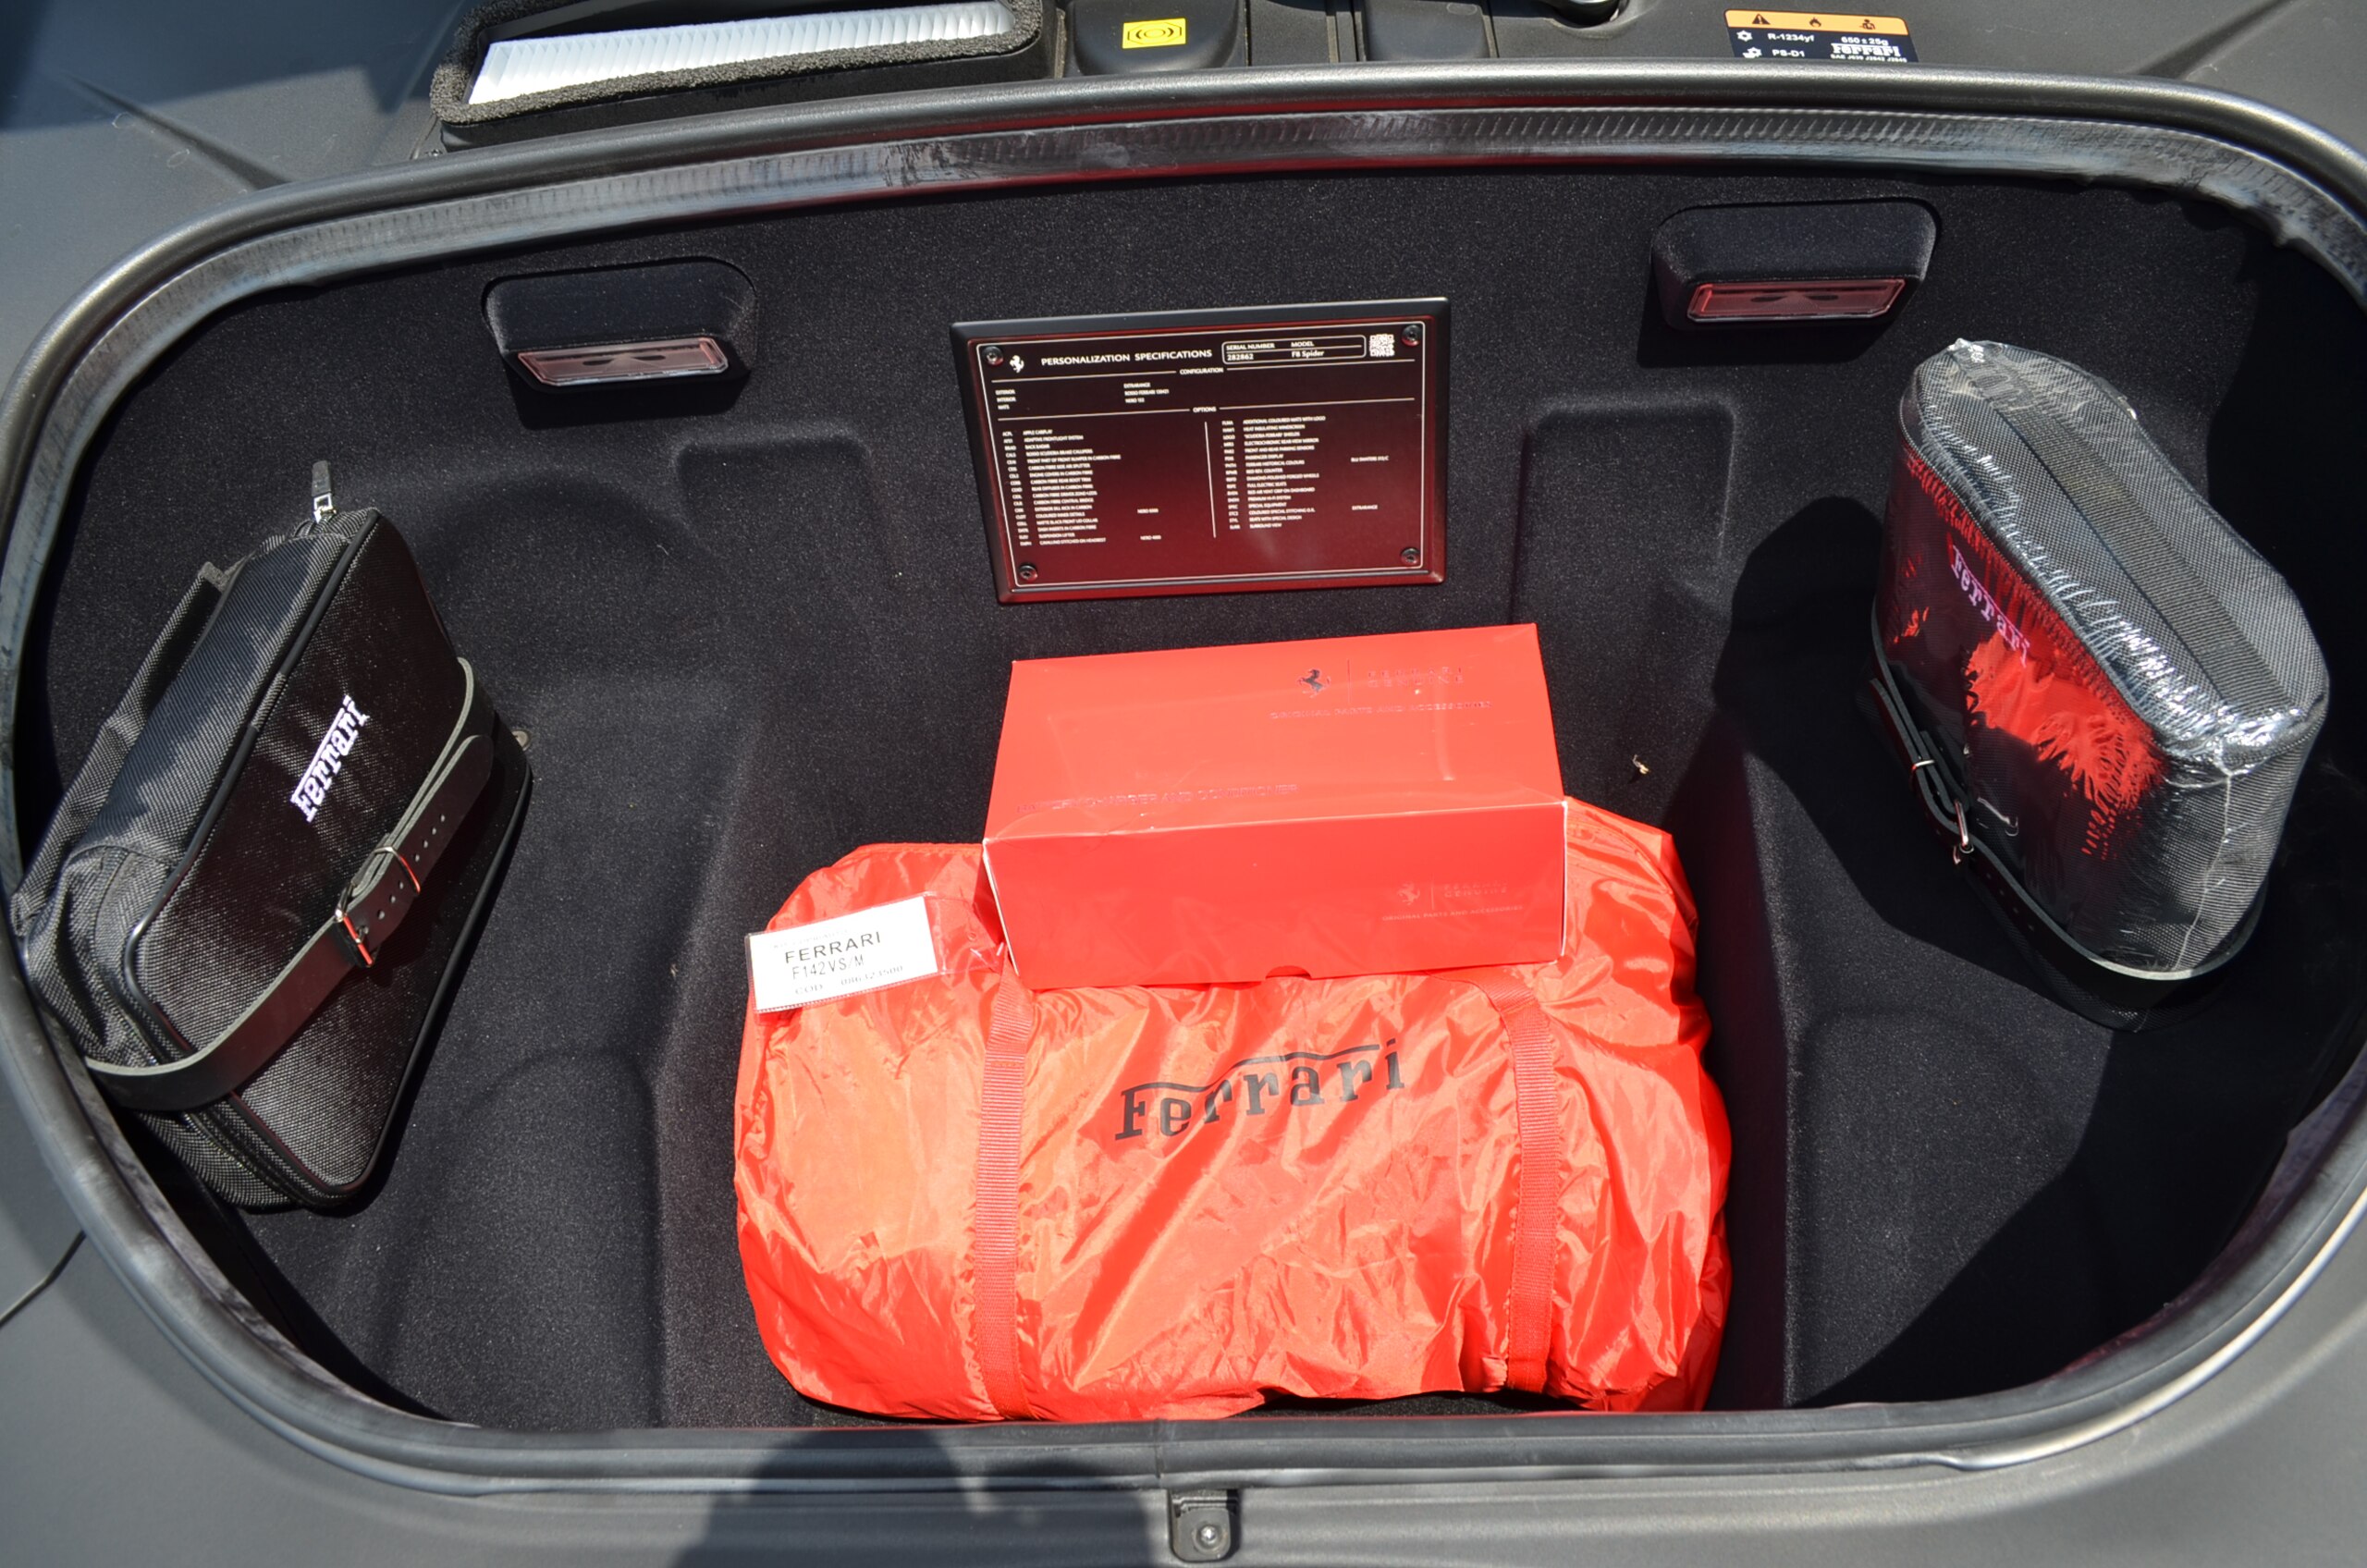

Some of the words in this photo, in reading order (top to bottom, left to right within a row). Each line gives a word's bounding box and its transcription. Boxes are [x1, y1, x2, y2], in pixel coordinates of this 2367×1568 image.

[1767, 32, 1815, 43] R-1234yf
[1840, 36, 1860, 44] 650
[1831, 43, 1901, 57] Ferrari
[1041, 354, 1131, 366] PERSONALIZATION
[1134, 349, 1213, 361] SPECIFICATIONS
[1302, 350, 1325, 359] Spider
[1179, 367, 1223, 375] CONFIGURATION
[1951, 544, 2030, 669] Ferrari
[289, 694, 371, 823] Ferrari
[785, 931, 881, 964] FERRARI
[1115, 1038, 1405, 1141] Ferrari
